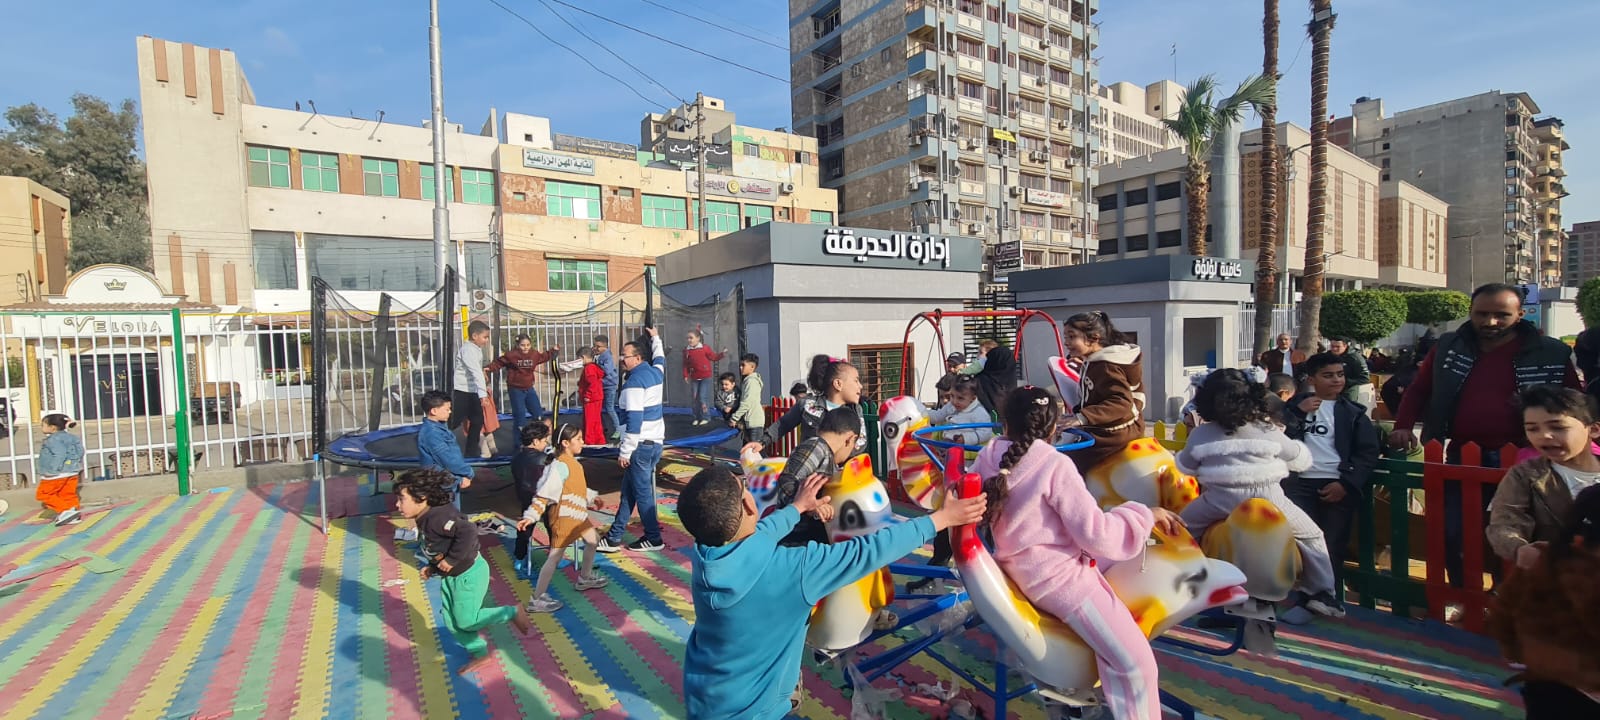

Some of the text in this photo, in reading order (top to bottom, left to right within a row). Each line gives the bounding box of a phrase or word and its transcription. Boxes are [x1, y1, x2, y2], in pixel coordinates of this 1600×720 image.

[825, 228, 950, 267] إدارة الحديقة
[1194, 258, 1217, 279] لؤلؤة
